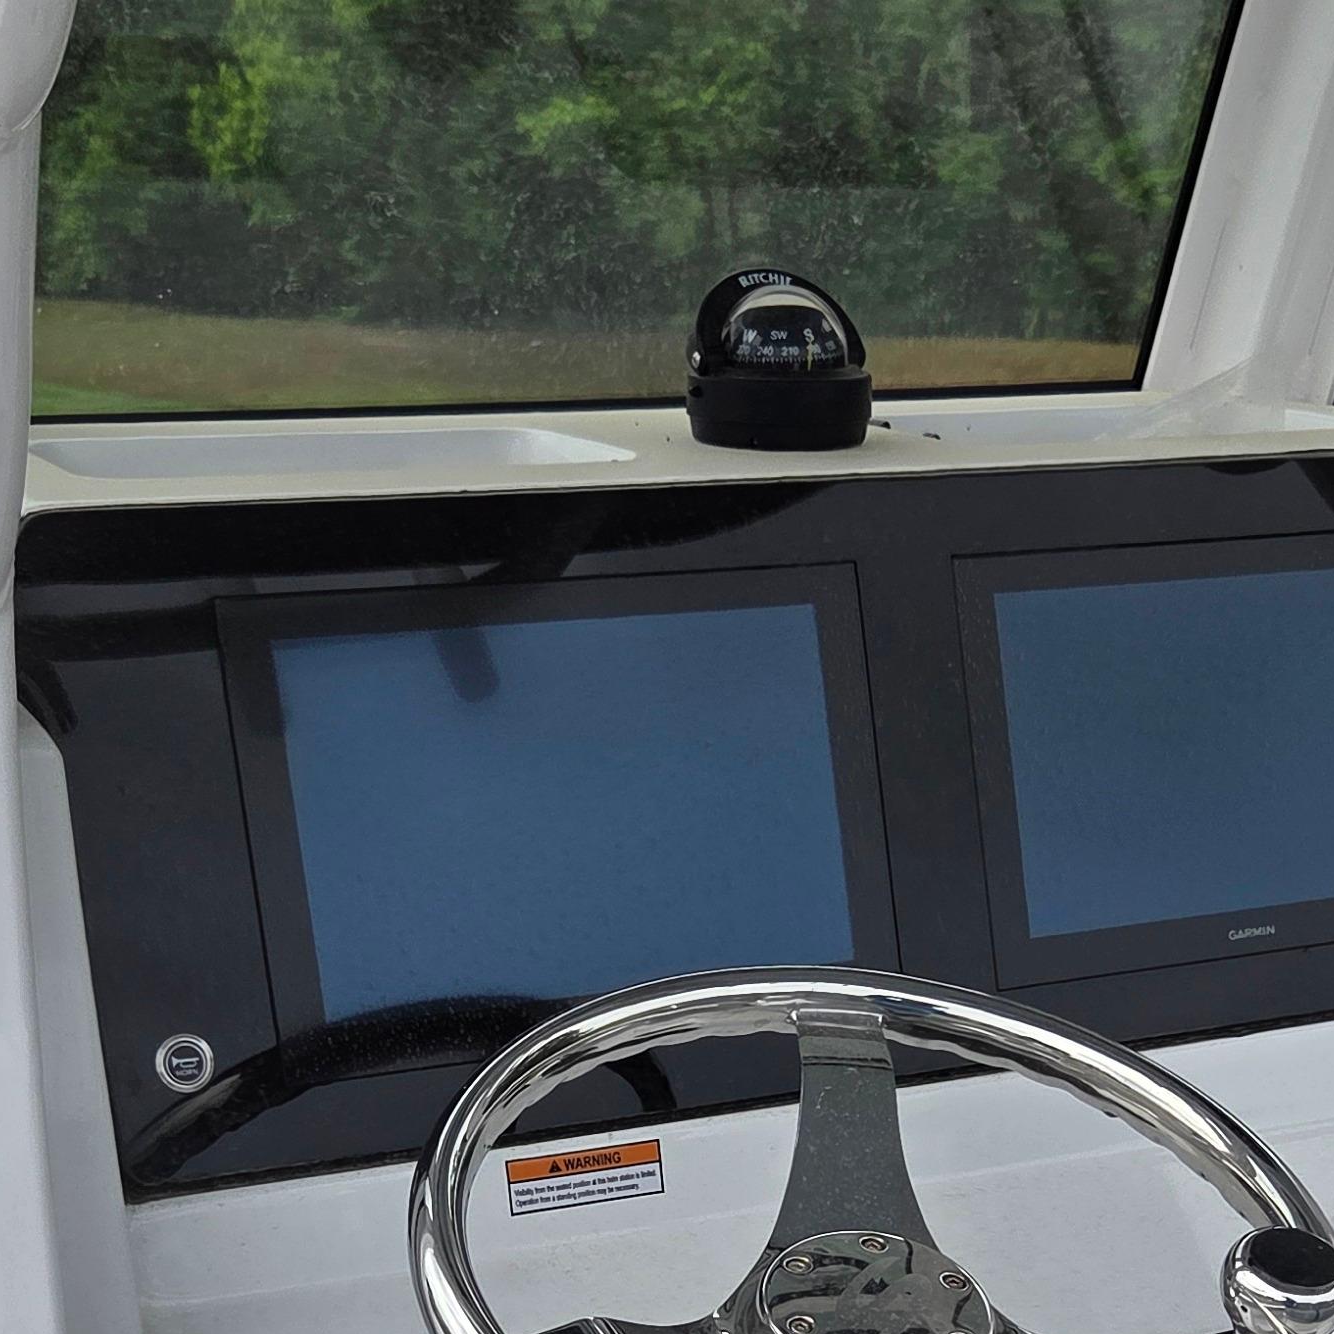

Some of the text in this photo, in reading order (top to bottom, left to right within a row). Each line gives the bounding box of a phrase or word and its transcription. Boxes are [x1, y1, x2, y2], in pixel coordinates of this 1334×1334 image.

[738, 273, 793, 287] RITCHIE
[770, 330, 787, 340] SW
[803, 328, 814, 342] S
[780, 346, 799, 356] 210
[1228, 925, 1275, 940] GARMIN
[564, 1151, 621, 1171] WARNING
